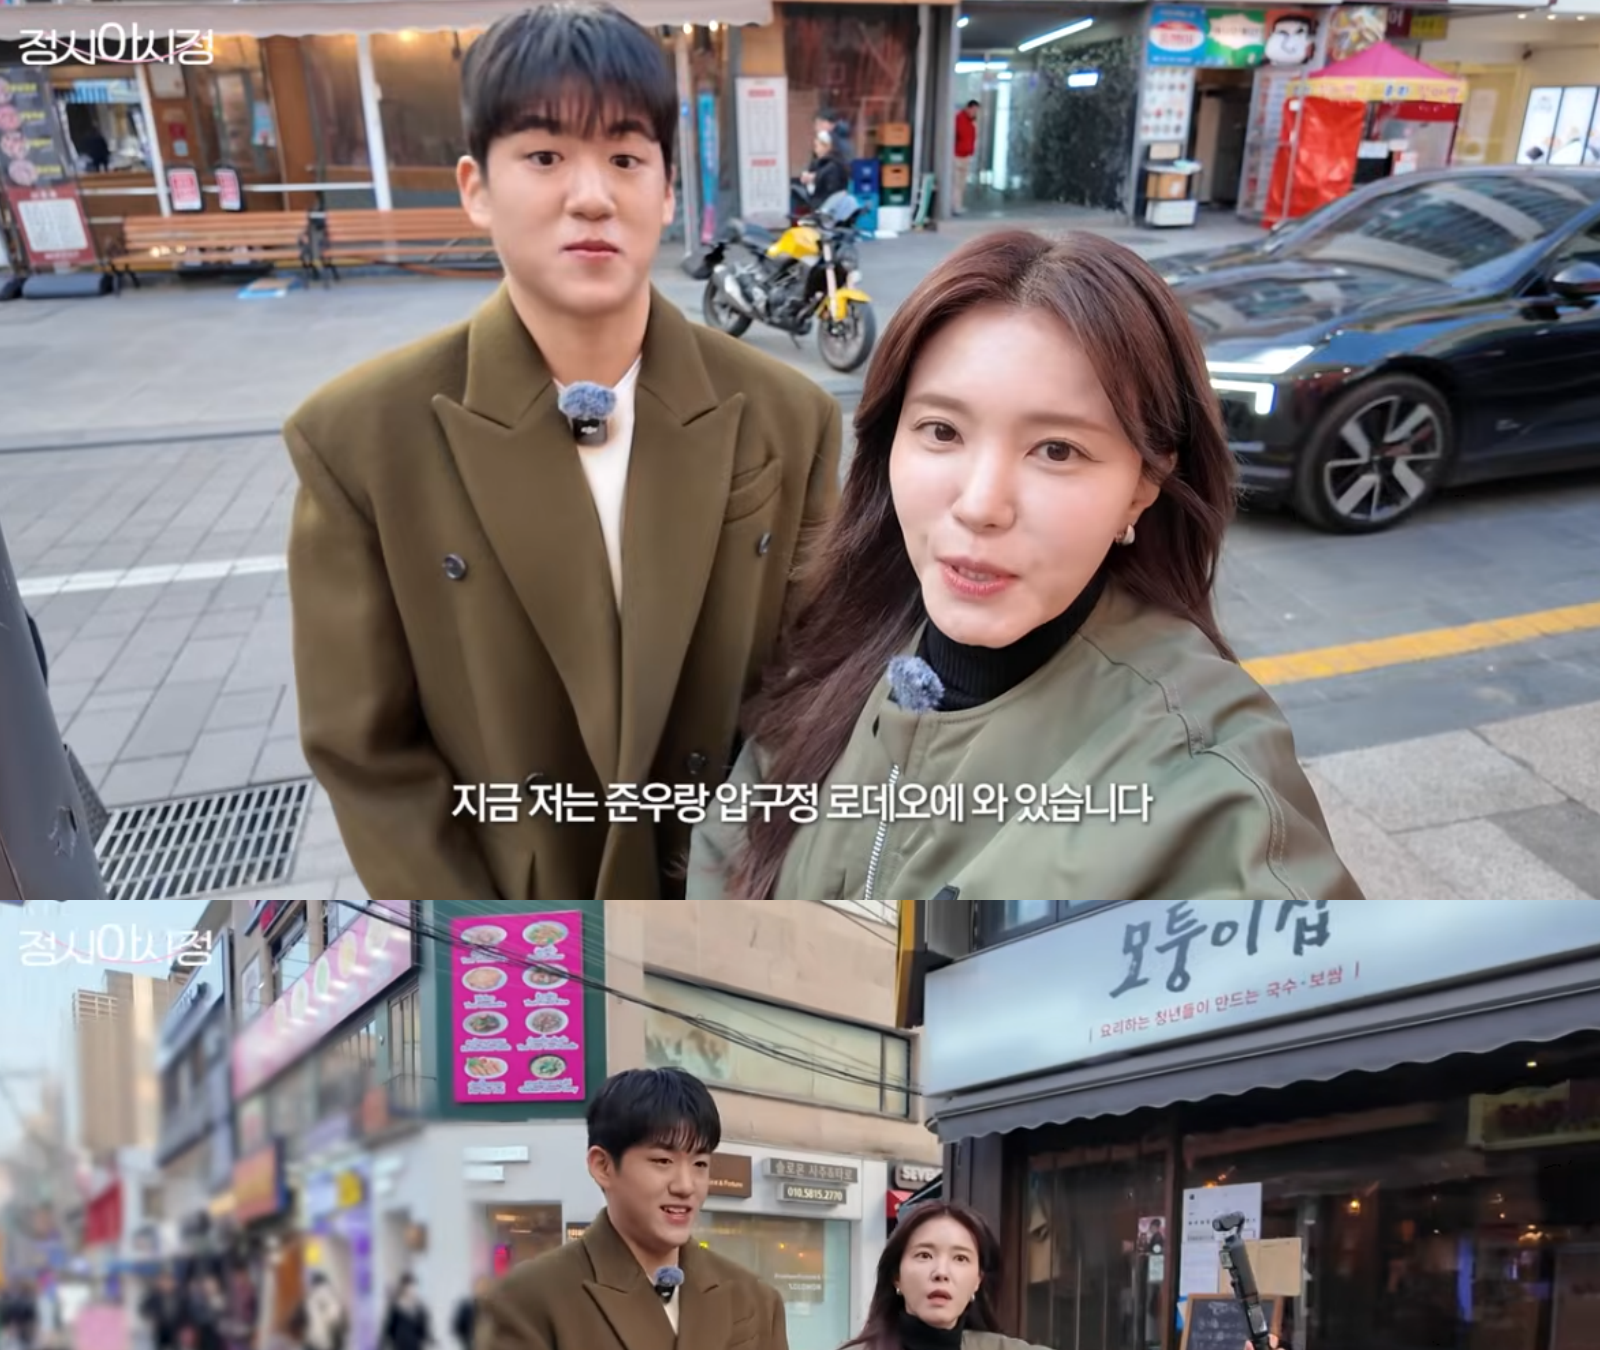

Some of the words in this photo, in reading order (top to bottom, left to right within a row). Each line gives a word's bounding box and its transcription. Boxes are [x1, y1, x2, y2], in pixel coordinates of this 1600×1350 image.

[1100, 1013, 1151, 1039] 요리하는
[1154, 998, 1210, 1028] 청년들이
[1214, 988, 1261, 1013] 만드는
[787, 1186, 843, 1201] 010.5815.2770
